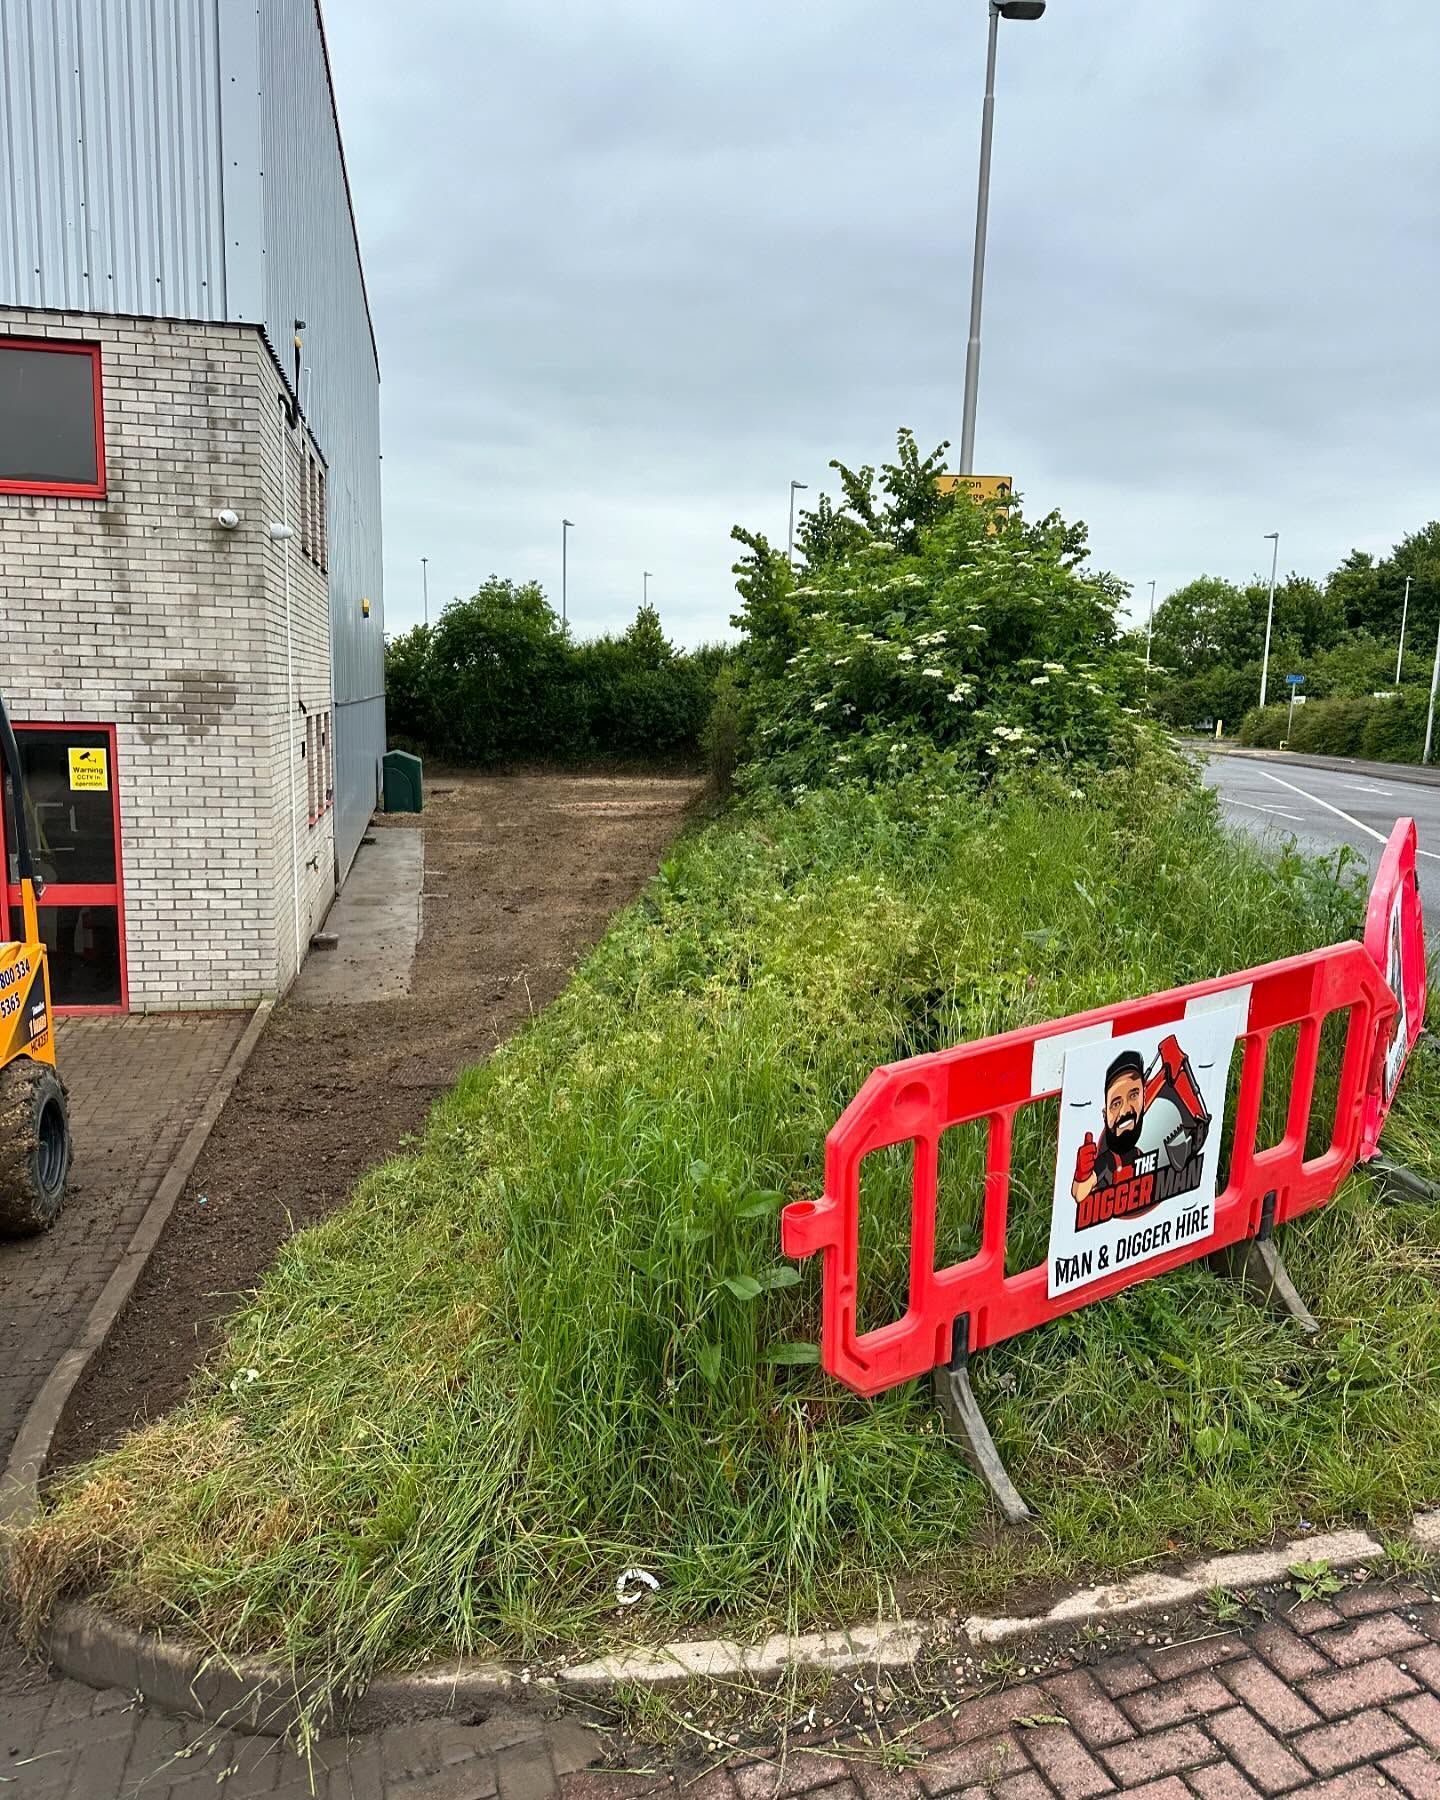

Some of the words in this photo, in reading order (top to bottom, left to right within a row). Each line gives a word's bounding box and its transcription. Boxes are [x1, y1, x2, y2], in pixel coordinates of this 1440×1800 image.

[73, 766, 104, 775] Warning
[15, 958, 31, 980] 334
[0, 992, 21, 1018] 5365
[1134, 1152, 1157, 1177] THE
[1077, 1174, 1154, 1228] DIGGER
[1154, 1155, 1204, 1202] MAN
[1055, 1250, 1092, 1288] MAN
[1098, 1245, 1109, 1270] &
[1115, 1221, 1172, 1264] DIGGER
[1175, 1205, 1210, 1241] HIRE
